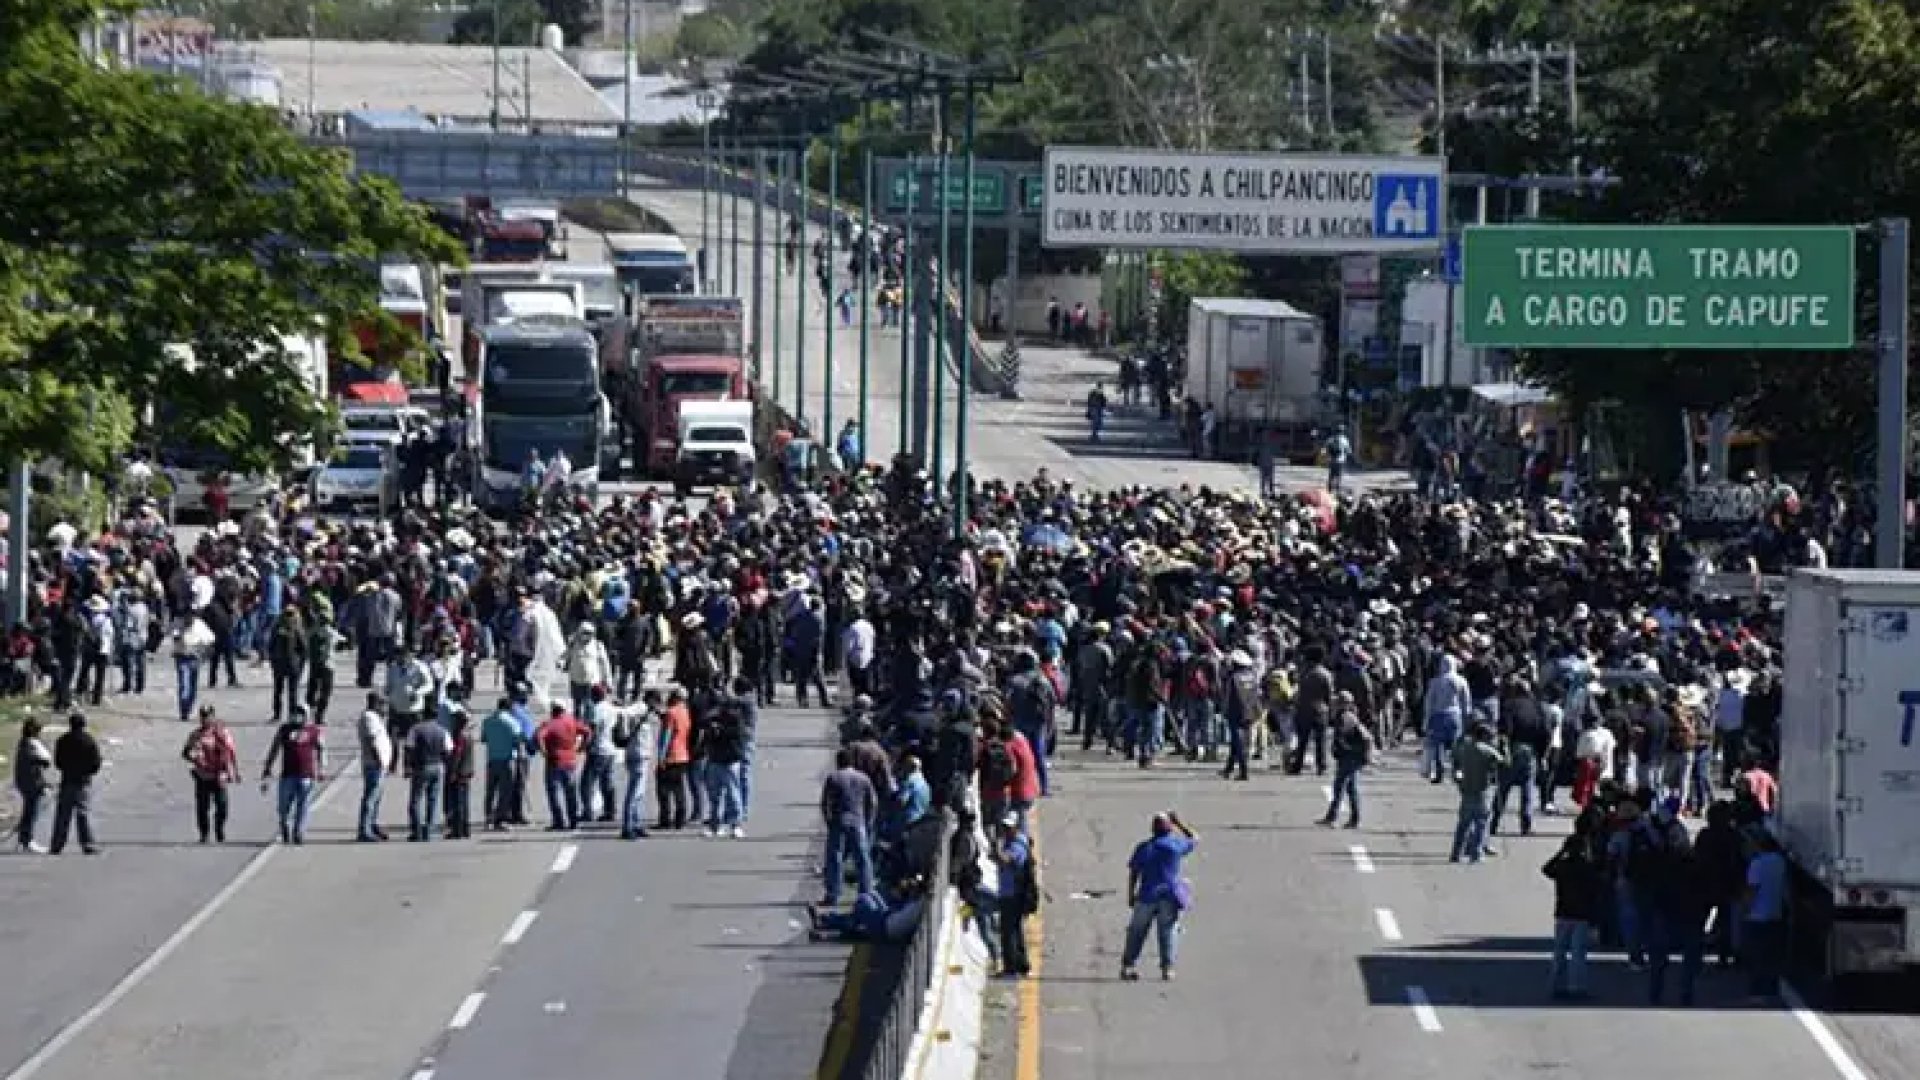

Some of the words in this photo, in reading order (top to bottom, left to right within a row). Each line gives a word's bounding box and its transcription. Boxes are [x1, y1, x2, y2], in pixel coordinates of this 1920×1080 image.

[1054, 164, 1191, 198] BIENVENIDOS
[1199, 167, 1214, 198] A
[1223, 168, 1373, 202] CHILPANCINGO
[1054, 209, 1092, 231] CUNA
[1101, 210, 1117, 233] DE
[1125, 211, 1153, 233] LOS
[1159, 211, 1261, 237] SENTIMIENTOS
[1269, 215, 1286, 237] DE
[1293, 216, 1312, 237] LA
[1515, 248, 1655, 279] TERMINA
[1689, 248, 1799, 279] TRAMO
[1485, 297, 1505, 325] A
[1524, 297, 1627, 326] CARGO
[1647, 297, 1686, 326] DE
[1706, 297, 1829, 326] CAPUFE
